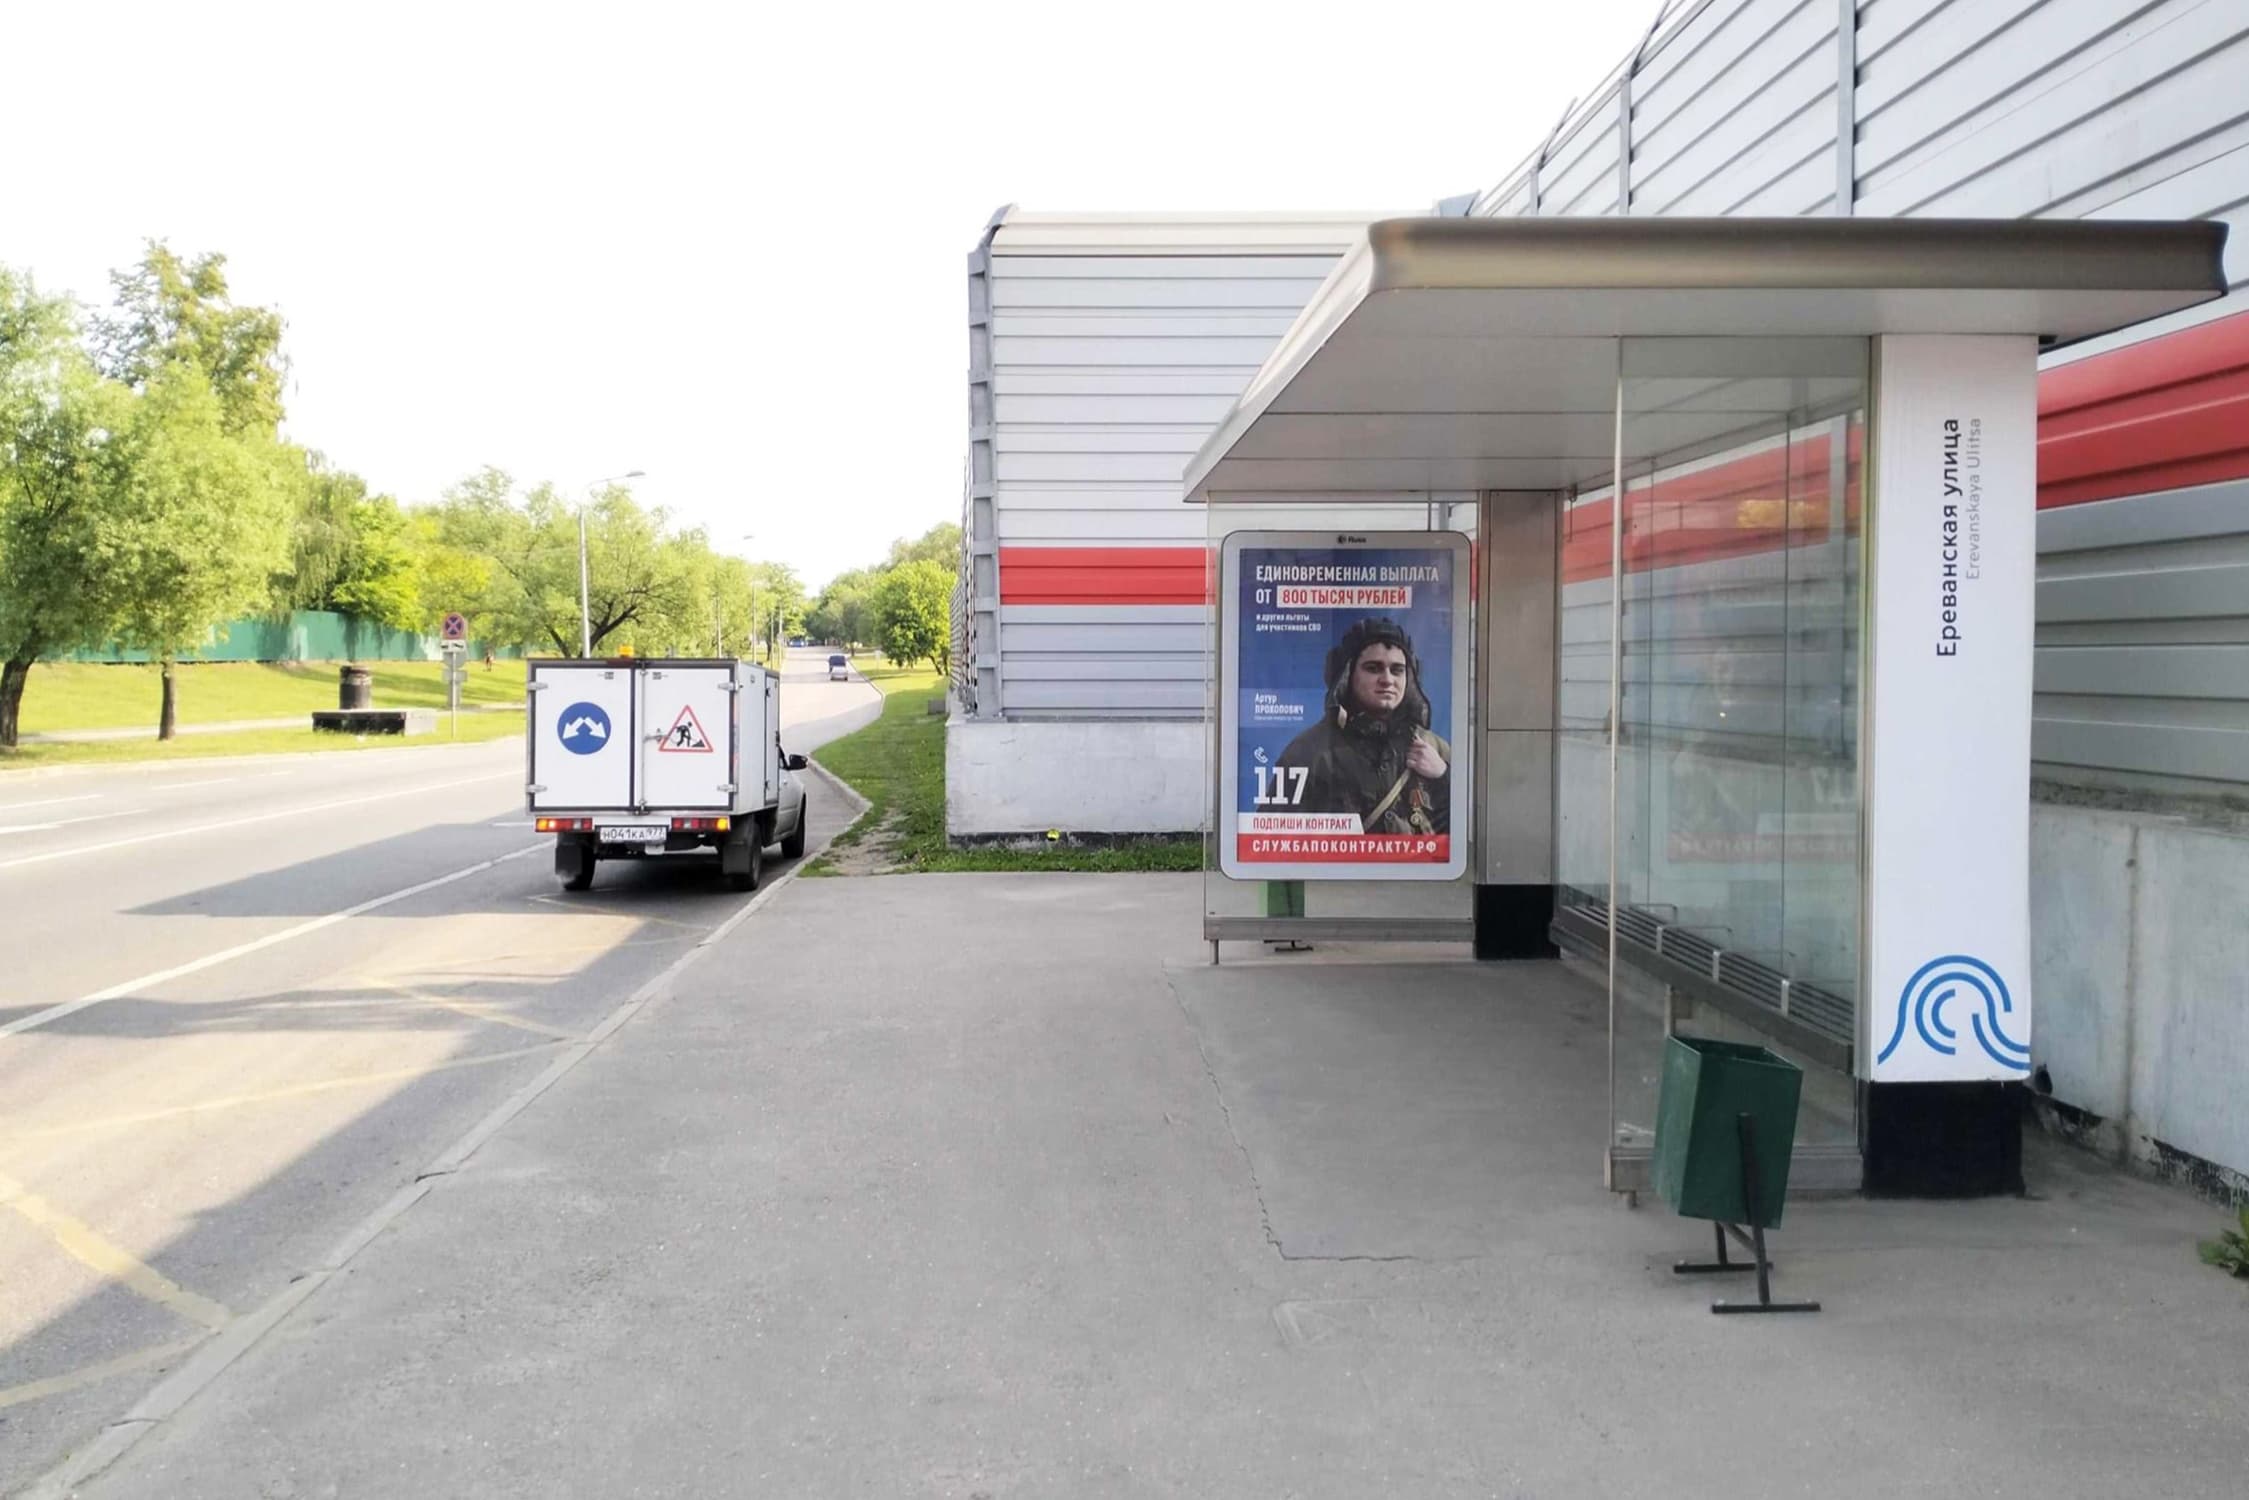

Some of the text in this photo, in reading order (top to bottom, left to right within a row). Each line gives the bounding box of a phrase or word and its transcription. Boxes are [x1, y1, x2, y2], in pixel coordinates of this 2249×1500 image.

[1966, 418, 1984, 580] Erevanskaya Ulitsa
[1936, 418, 1962, 657] Ереванская улица
[1256, 565, 1439, 582] ЕДИНОВРЕМЕННАЯ ВЫПЛАТА
[1256, 587, 1406, 604] ОТ 800 ТЫСЯЧ РУБЛЕЙ
[1255, 692, 1277, 703] Артур
[1253, 766, 1309, 805] 117
[1253, 818, 1352, 830] ПОДПИШИ КОНТРАКТ
[1253, 840, 1437, 853] СЛУЖБАПОКОНТРАКТУ.РФ
